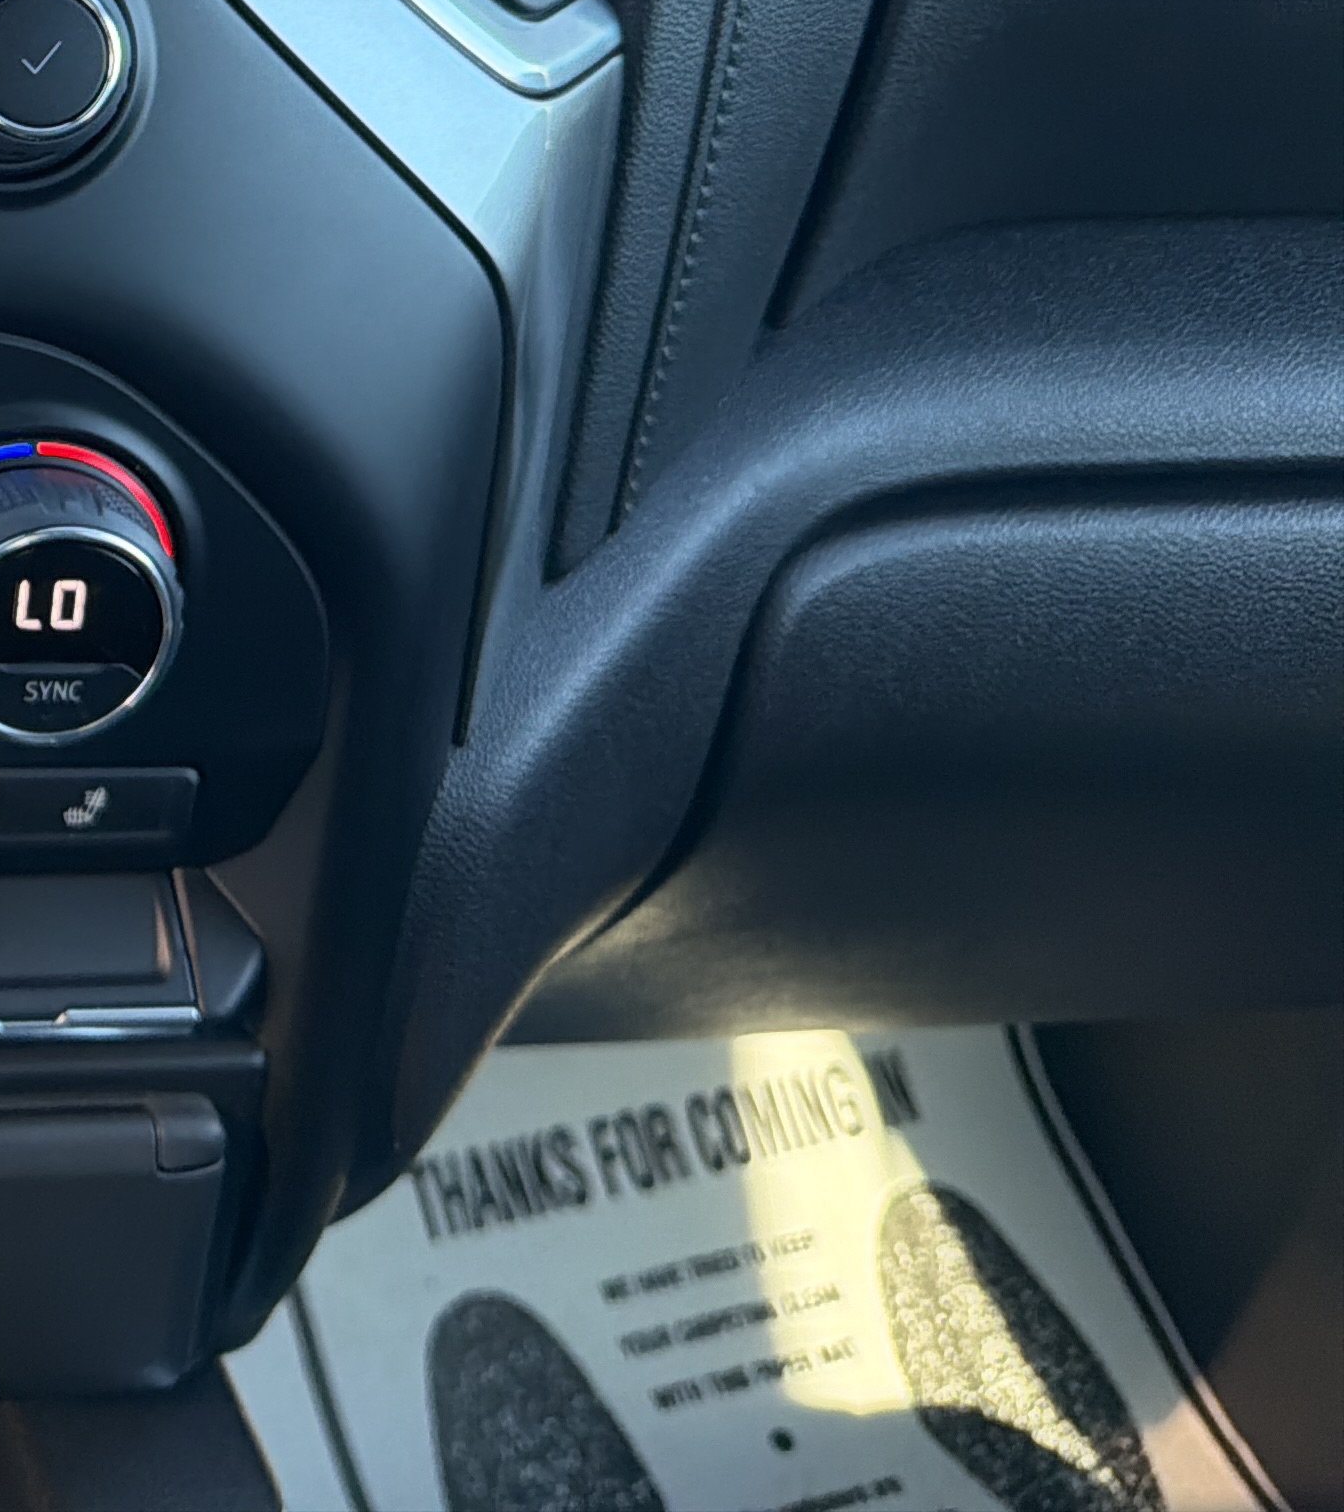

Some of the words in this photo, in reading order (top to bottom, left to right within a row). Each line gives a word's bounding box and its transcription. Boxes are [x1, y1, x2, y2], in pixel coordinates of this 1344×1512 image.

[23, 680, 83, 702] SYNC
[413, 1120, 587, 1240] THANKS
[587, 1101, 688, 1198] FOR
[686, 1060, 864, 1172] COMING
[865, 1046, 920, 1128] IN
